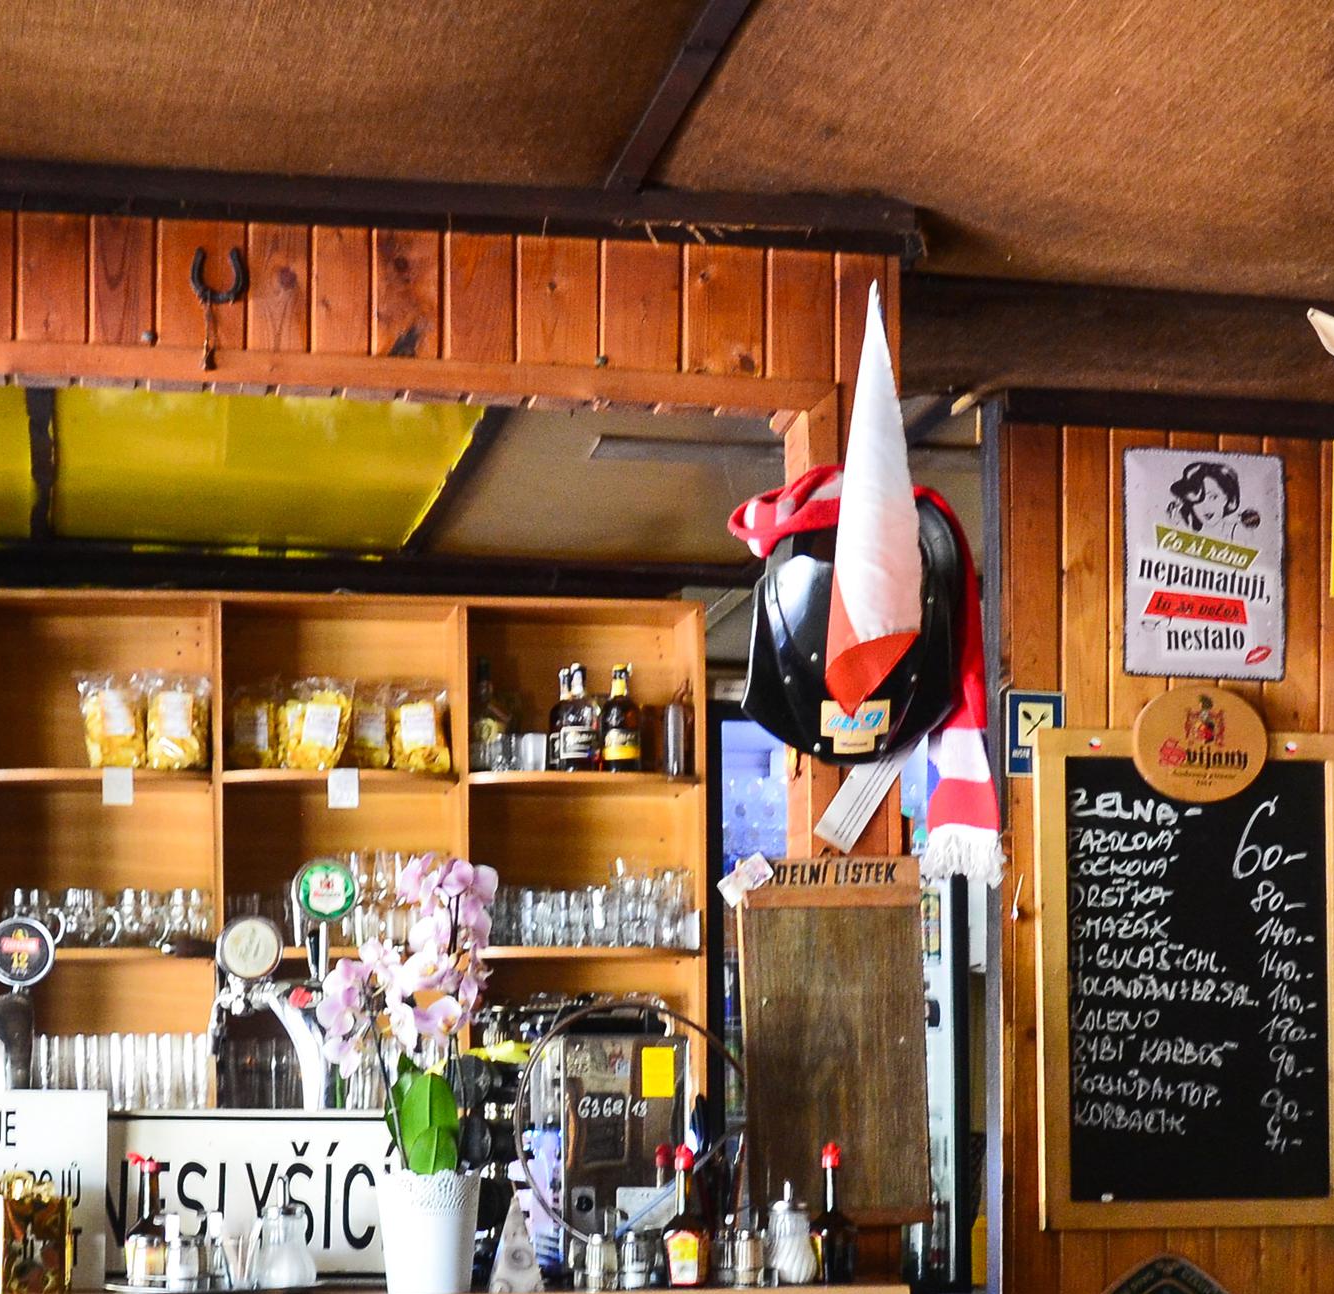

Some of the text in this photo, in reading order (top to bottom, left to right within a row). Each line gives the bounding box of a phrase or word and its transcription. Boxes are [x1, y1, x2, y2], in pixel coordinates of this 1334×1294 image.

[1159, 530, 1250, 568] Co si ráno
[1138, 556, 1272, 605] nepamatuji,
[1166, 624, 1246, 653] nestalo
[1157, 736, 1249, 771] Svijany
